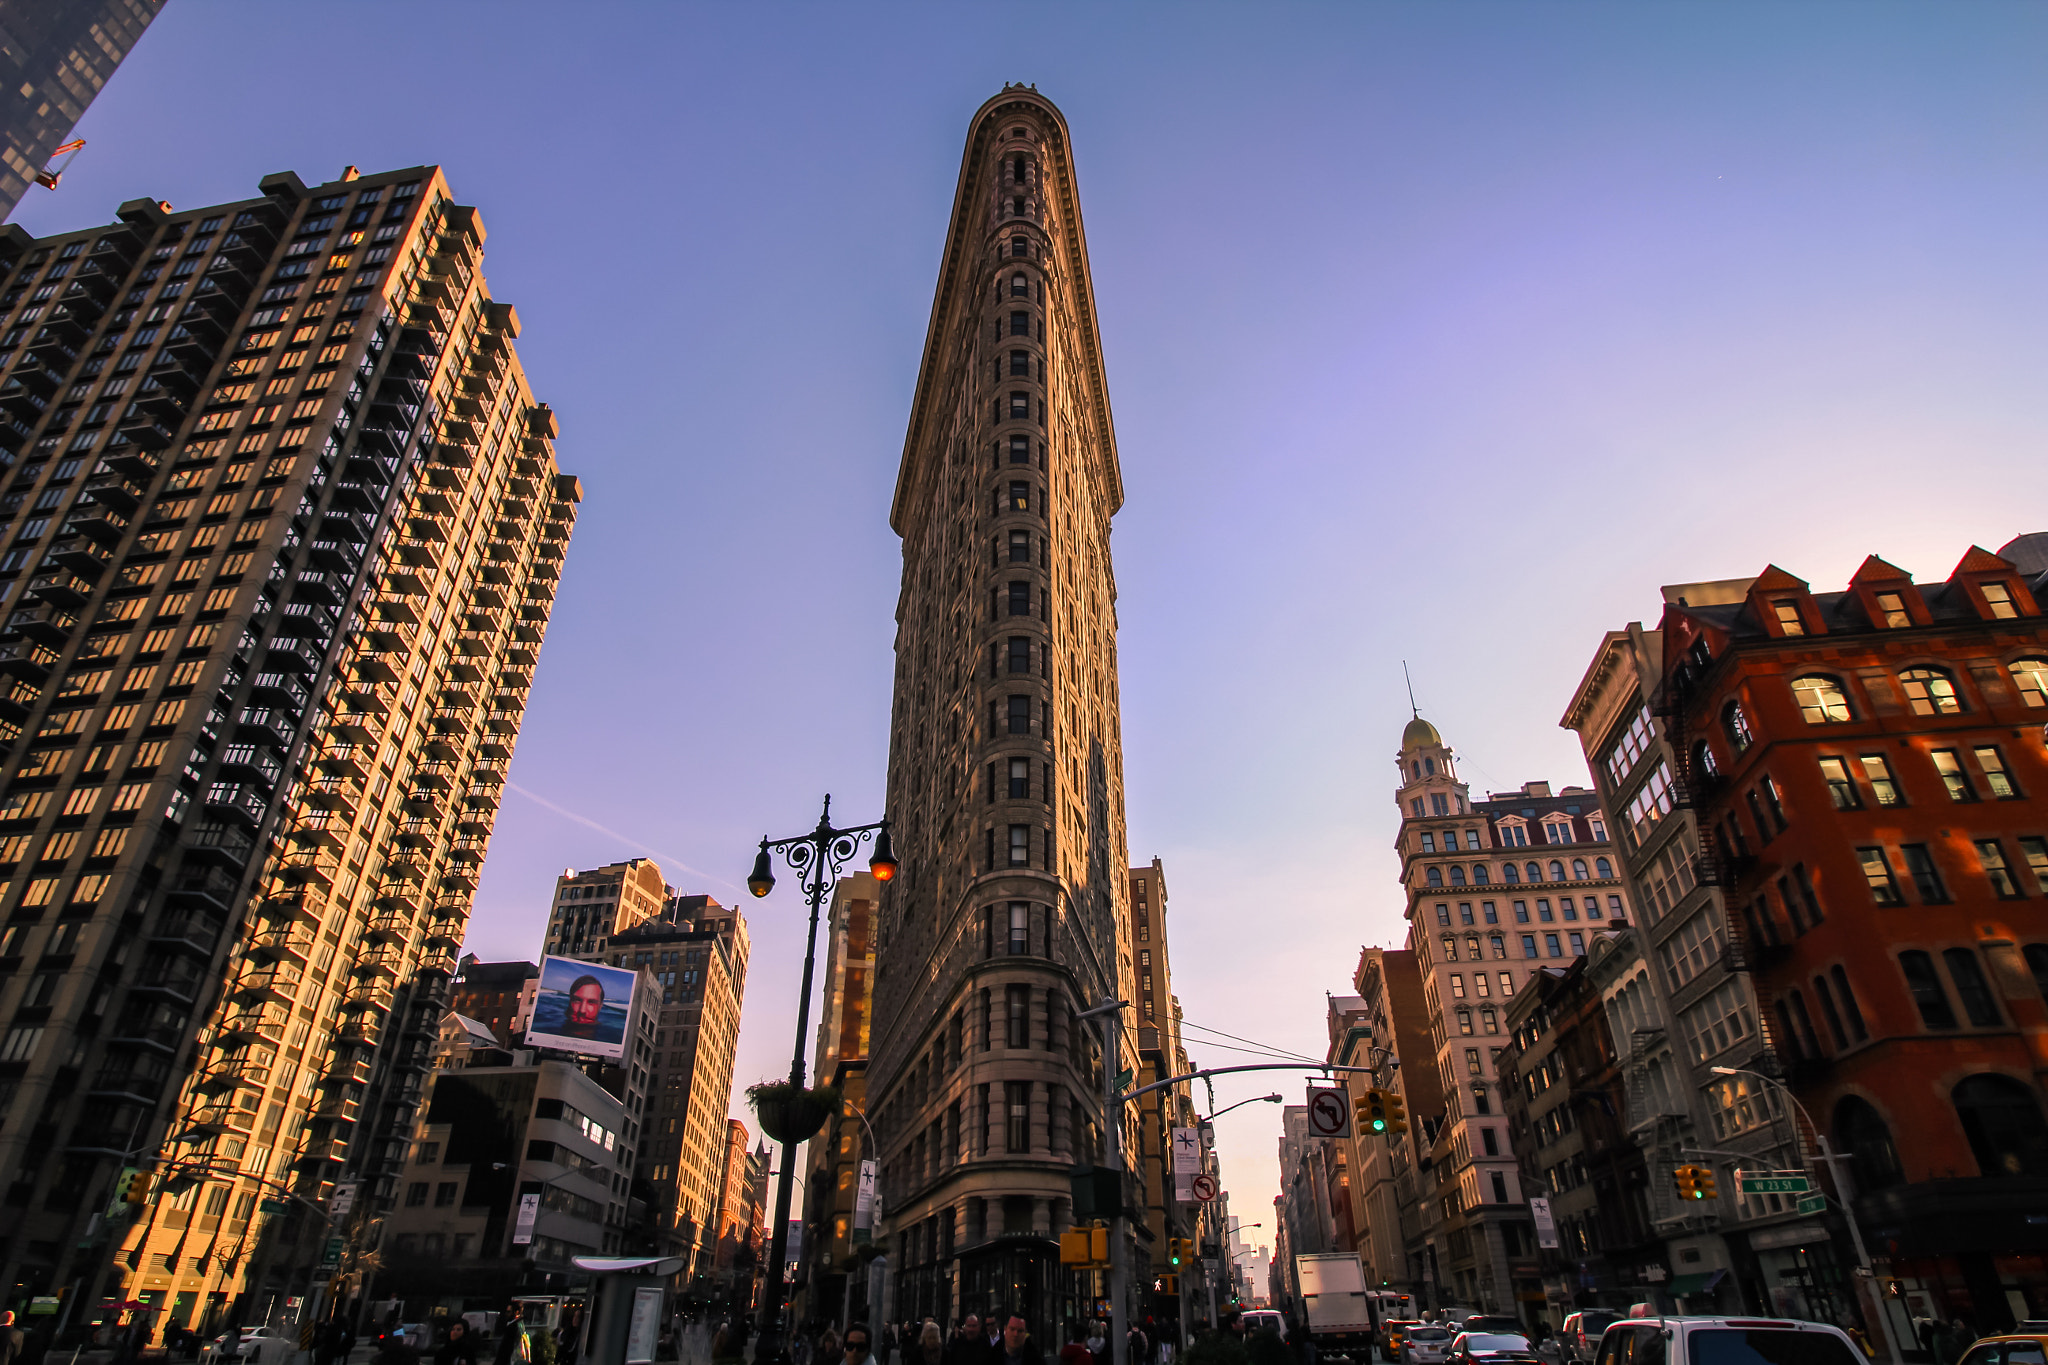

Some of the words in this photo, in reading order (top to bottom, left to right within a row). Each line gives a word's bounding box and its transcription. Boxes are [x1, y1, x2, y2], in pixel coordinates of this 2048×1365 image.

[1754, 1181, 1764, 1191] W
[1767, 1181, 1779, 1191] 23
[1782, 1180, 1792, 1190] St
